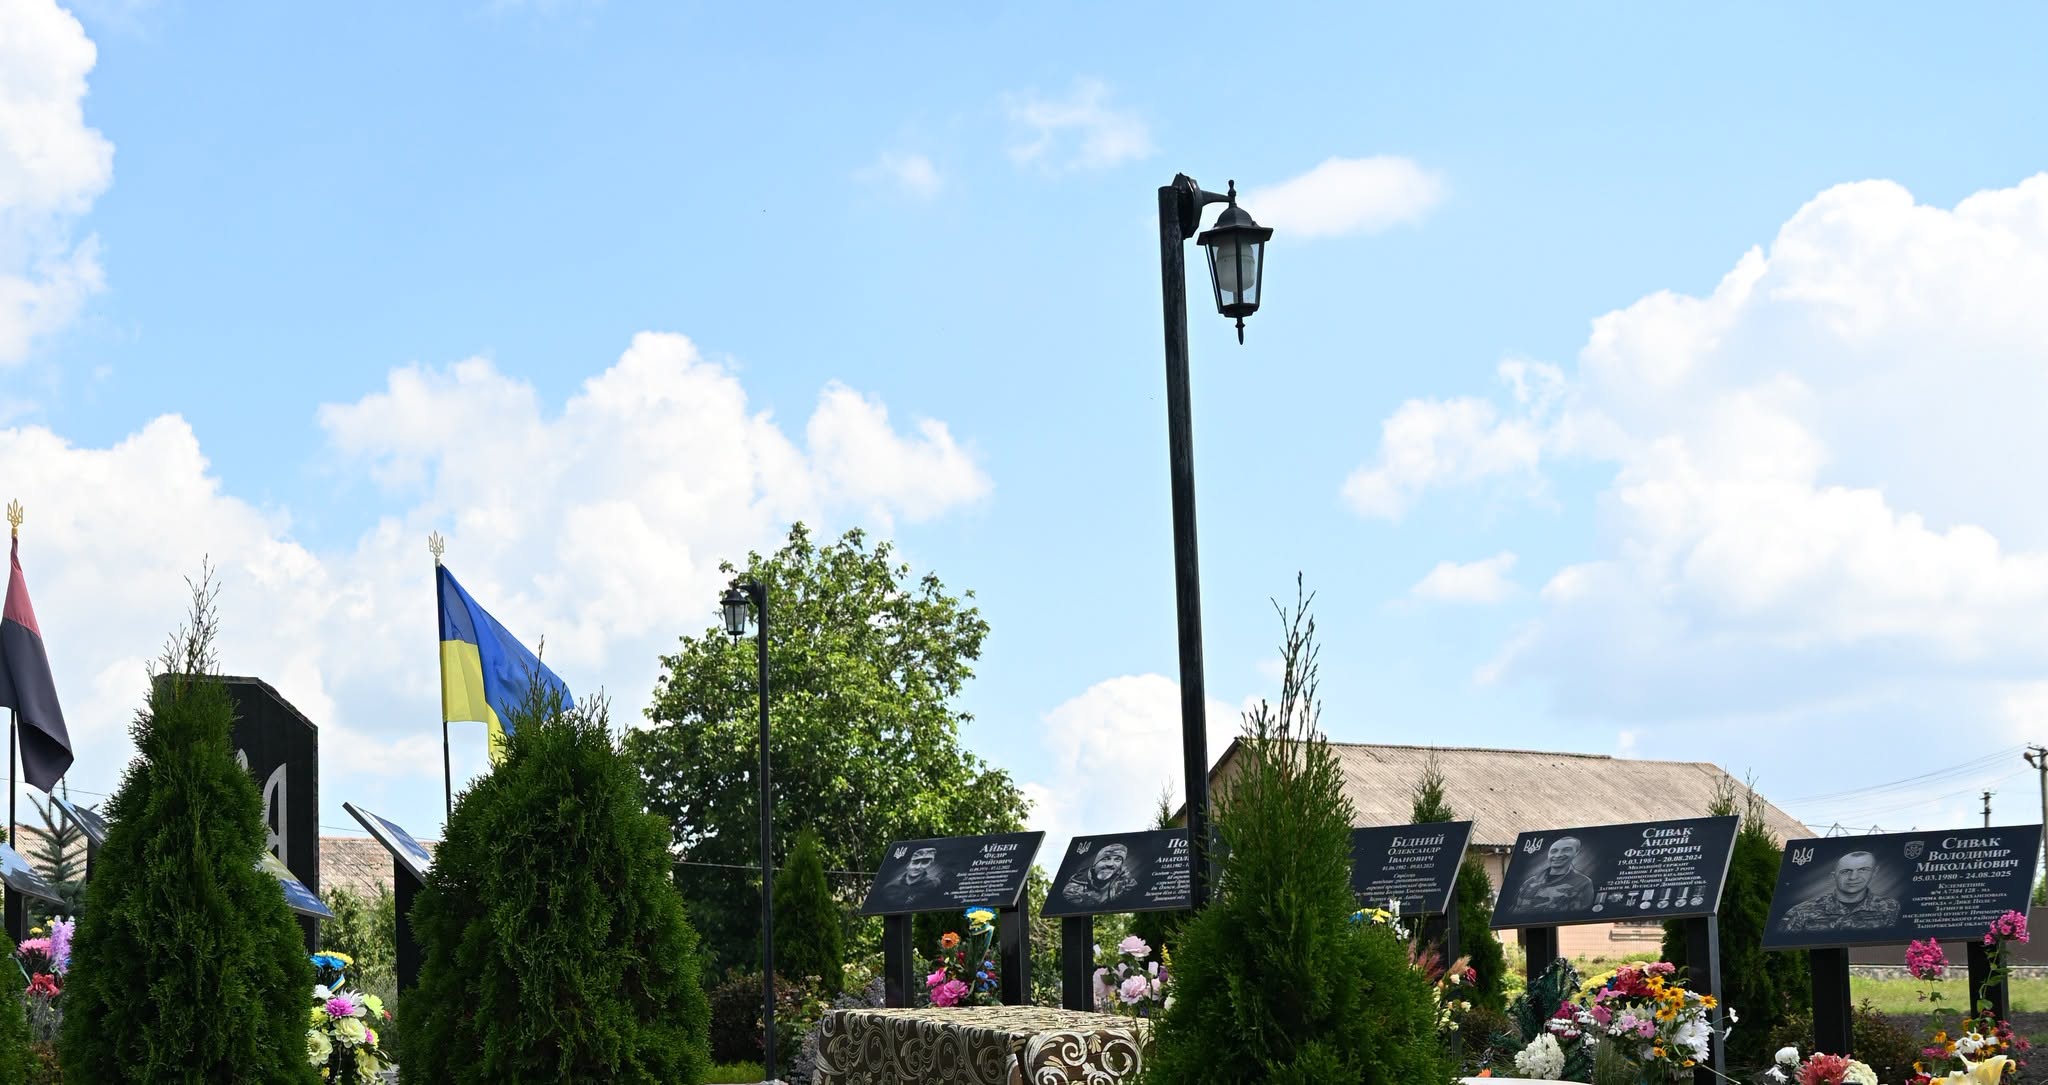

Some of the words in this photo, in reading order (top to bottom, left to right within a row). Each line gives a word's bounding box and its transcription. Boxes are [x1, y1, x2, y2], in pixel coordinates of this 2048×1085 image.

[1642, 827, 1694, 839] СИВАК
[1168, 838, 1188, 848] ПО
[1390, 833, 1445, 848] БІДНИЙ
[1640, 835, 1689, 847] АНДРІЙ
[1942, 837, 2001, 849] СИВАК
[1387, 847, 1441, 855] ОЛЕКСАНДР
[1624, 845, 1702, 857] ФЕДОРОВИЧ
[1928, 849, 2011, 861] ВОЛОДИМИР
[1388, 855, 1434, 863] ІВАНОВИЧ
[1662, 854, 1703, 863] 20.08.2024
[1915, 859, 2019, 872] МИКОЛАЙОВИЧ
[1912, 873, 1958, 882] 05.03.1980
[1965, 870, 2012, 879] 24.08.2025
